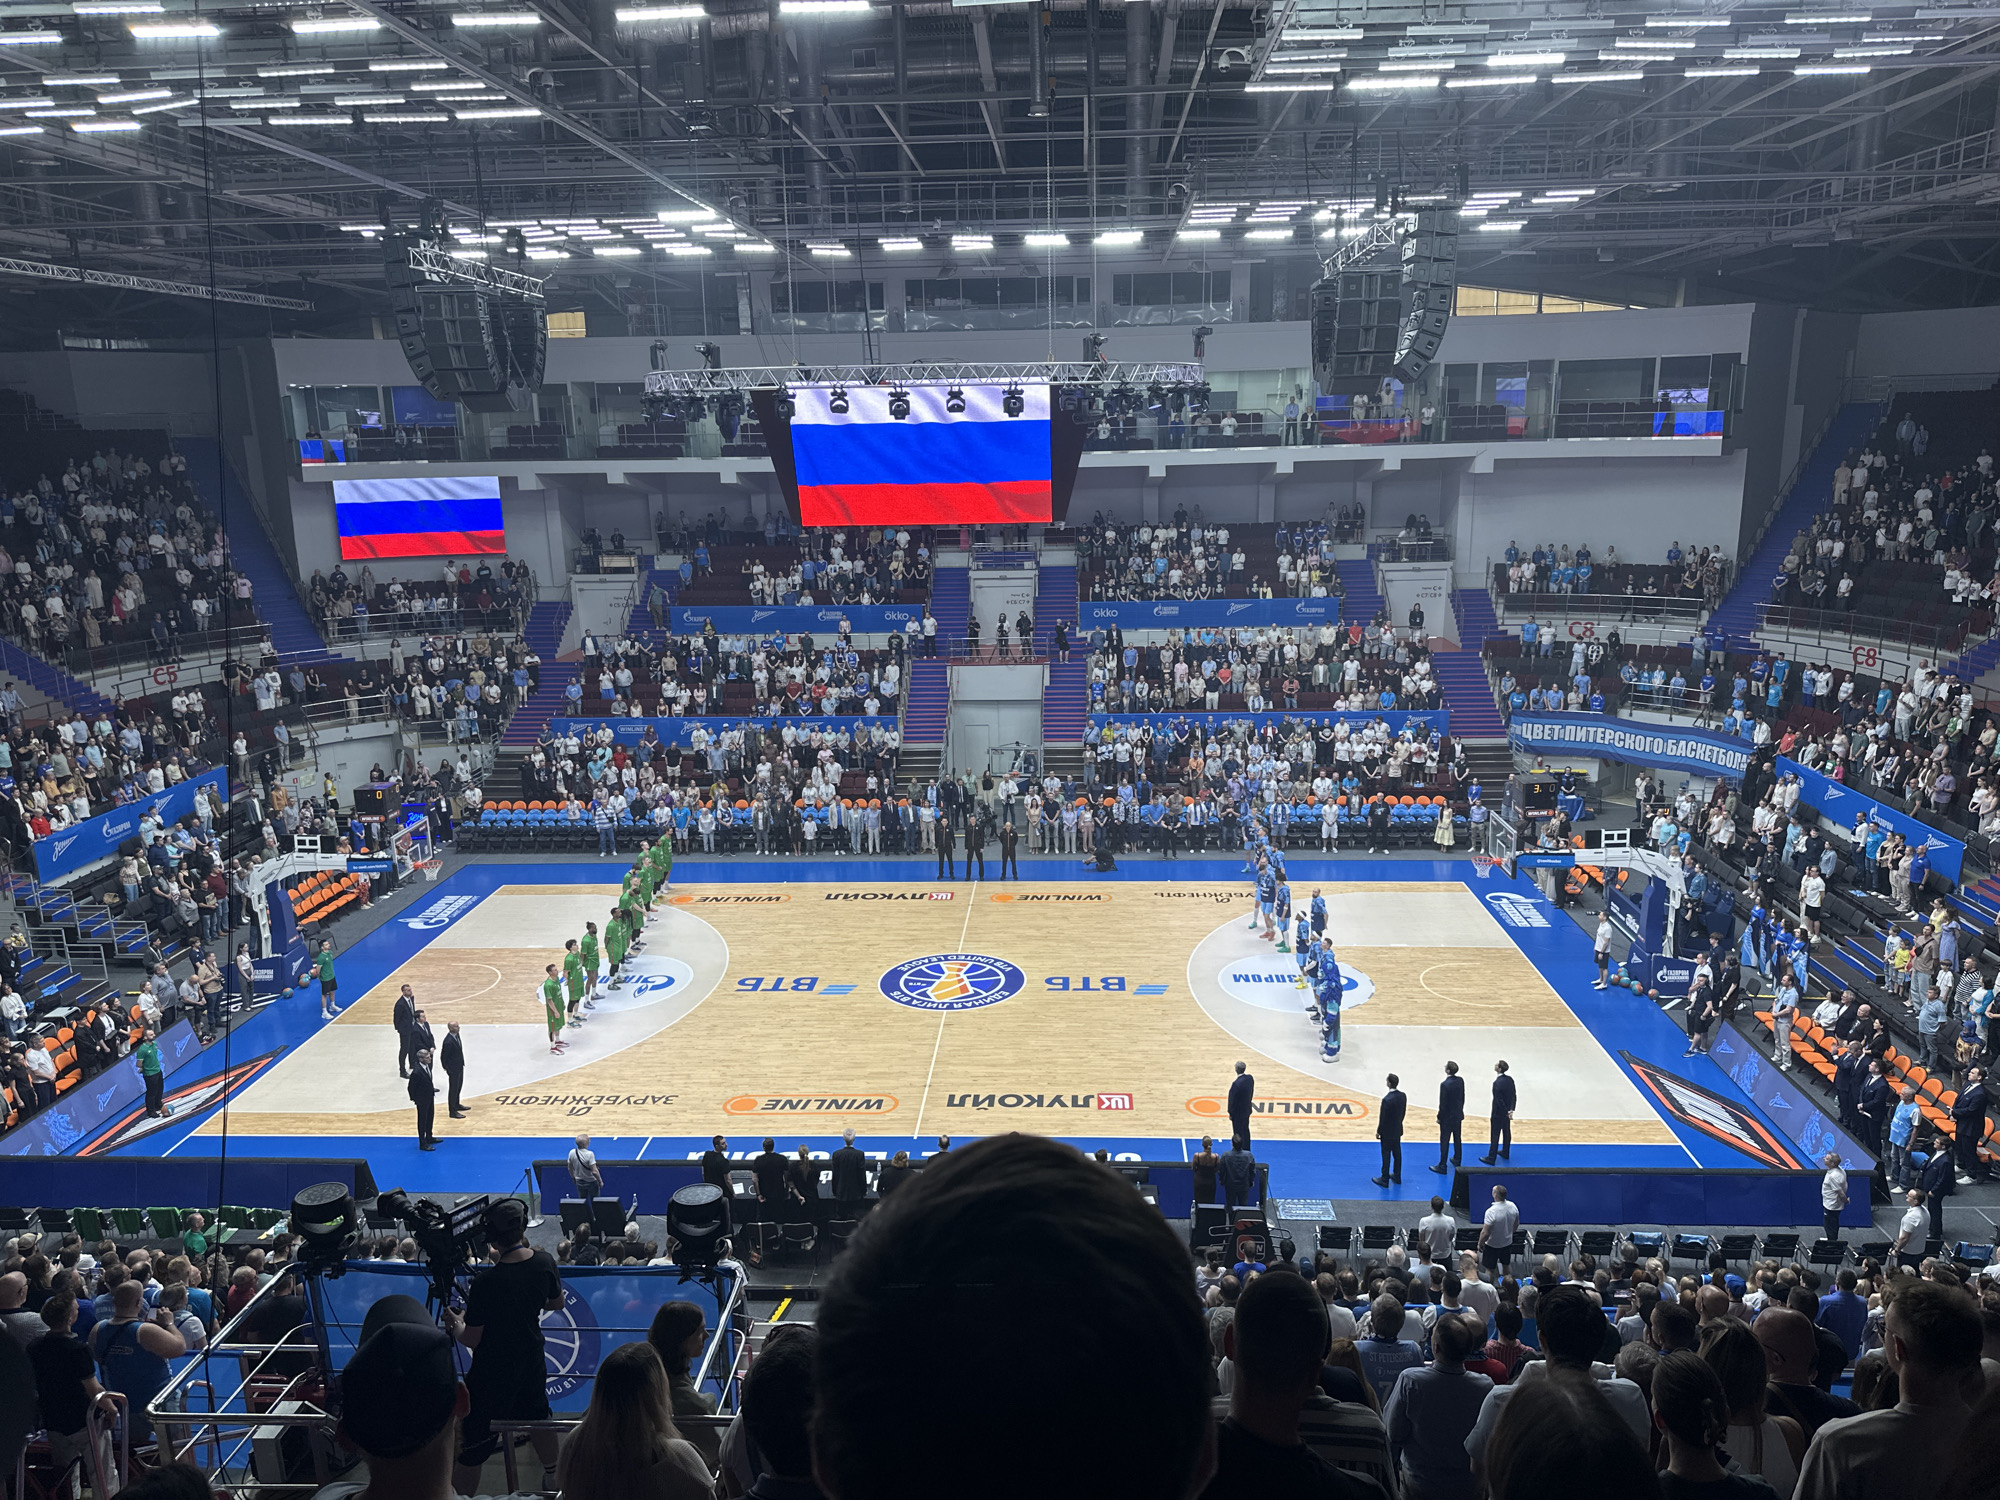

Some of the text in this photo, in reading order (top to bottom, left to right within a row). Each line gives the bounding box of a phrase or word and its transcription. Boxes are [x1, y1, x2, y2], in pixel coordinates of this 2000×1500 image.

[1521, 722, 1563, 742] ЦВЕТ
[1563, 726, 1664, 755] ПИТЕРСКОГО
[825, 892, 928, 902] ЛУКОЙЛ
[896, 954, 1014, 973] VTB UNITED LEAGUE
[734, 976, 820, 992] ВТБ
[1044, 976, 1127, 992] ВТБ
[889, 990, 1010, 1010] ЕДИНАЯ ЛИГА ВТБ
[495, 1094, 679, 1106] ЗАРУБЕЖНЕФТЬ
[761, 1098, 884, 1111] WINLINE
[946, 1093, 1096, 1111] ЛУКОЙЛ
[1251, 1102, 1353, 1115] WINLIN
